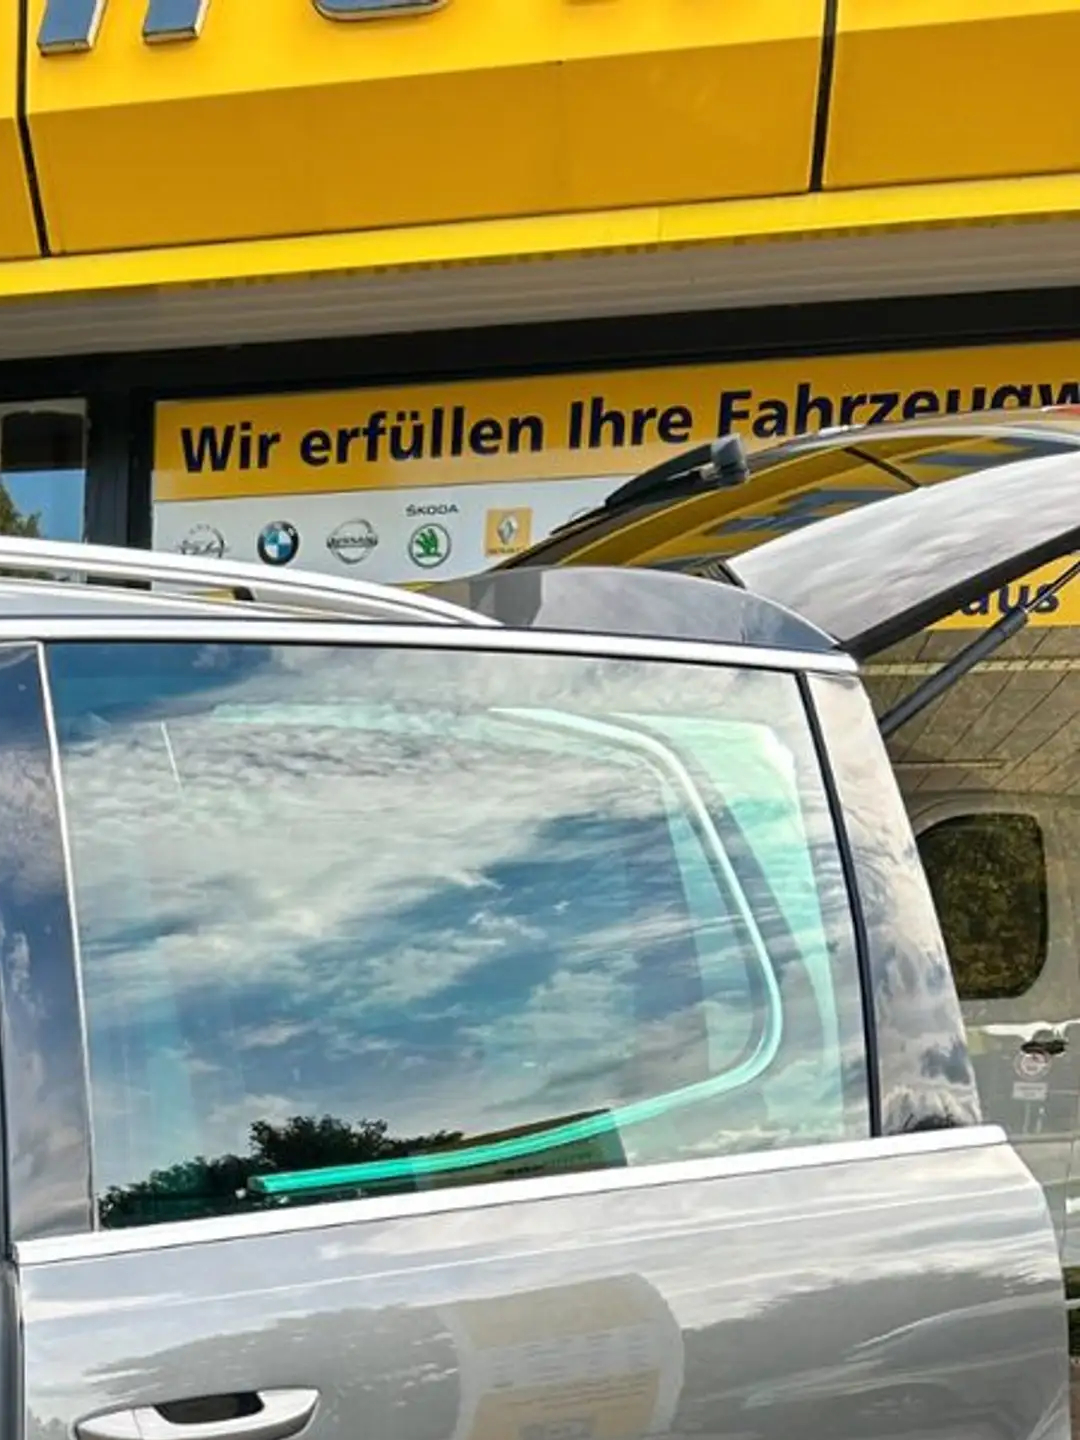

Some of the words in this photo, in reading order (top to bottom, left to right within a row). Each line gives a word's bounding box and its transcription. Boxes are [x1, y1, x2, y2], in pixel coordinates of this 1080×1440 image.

[180, 420, 282, 474] Wir
[299, 406, 544, 467] erfüllen
[569, 396, 694, 450] Ihre
